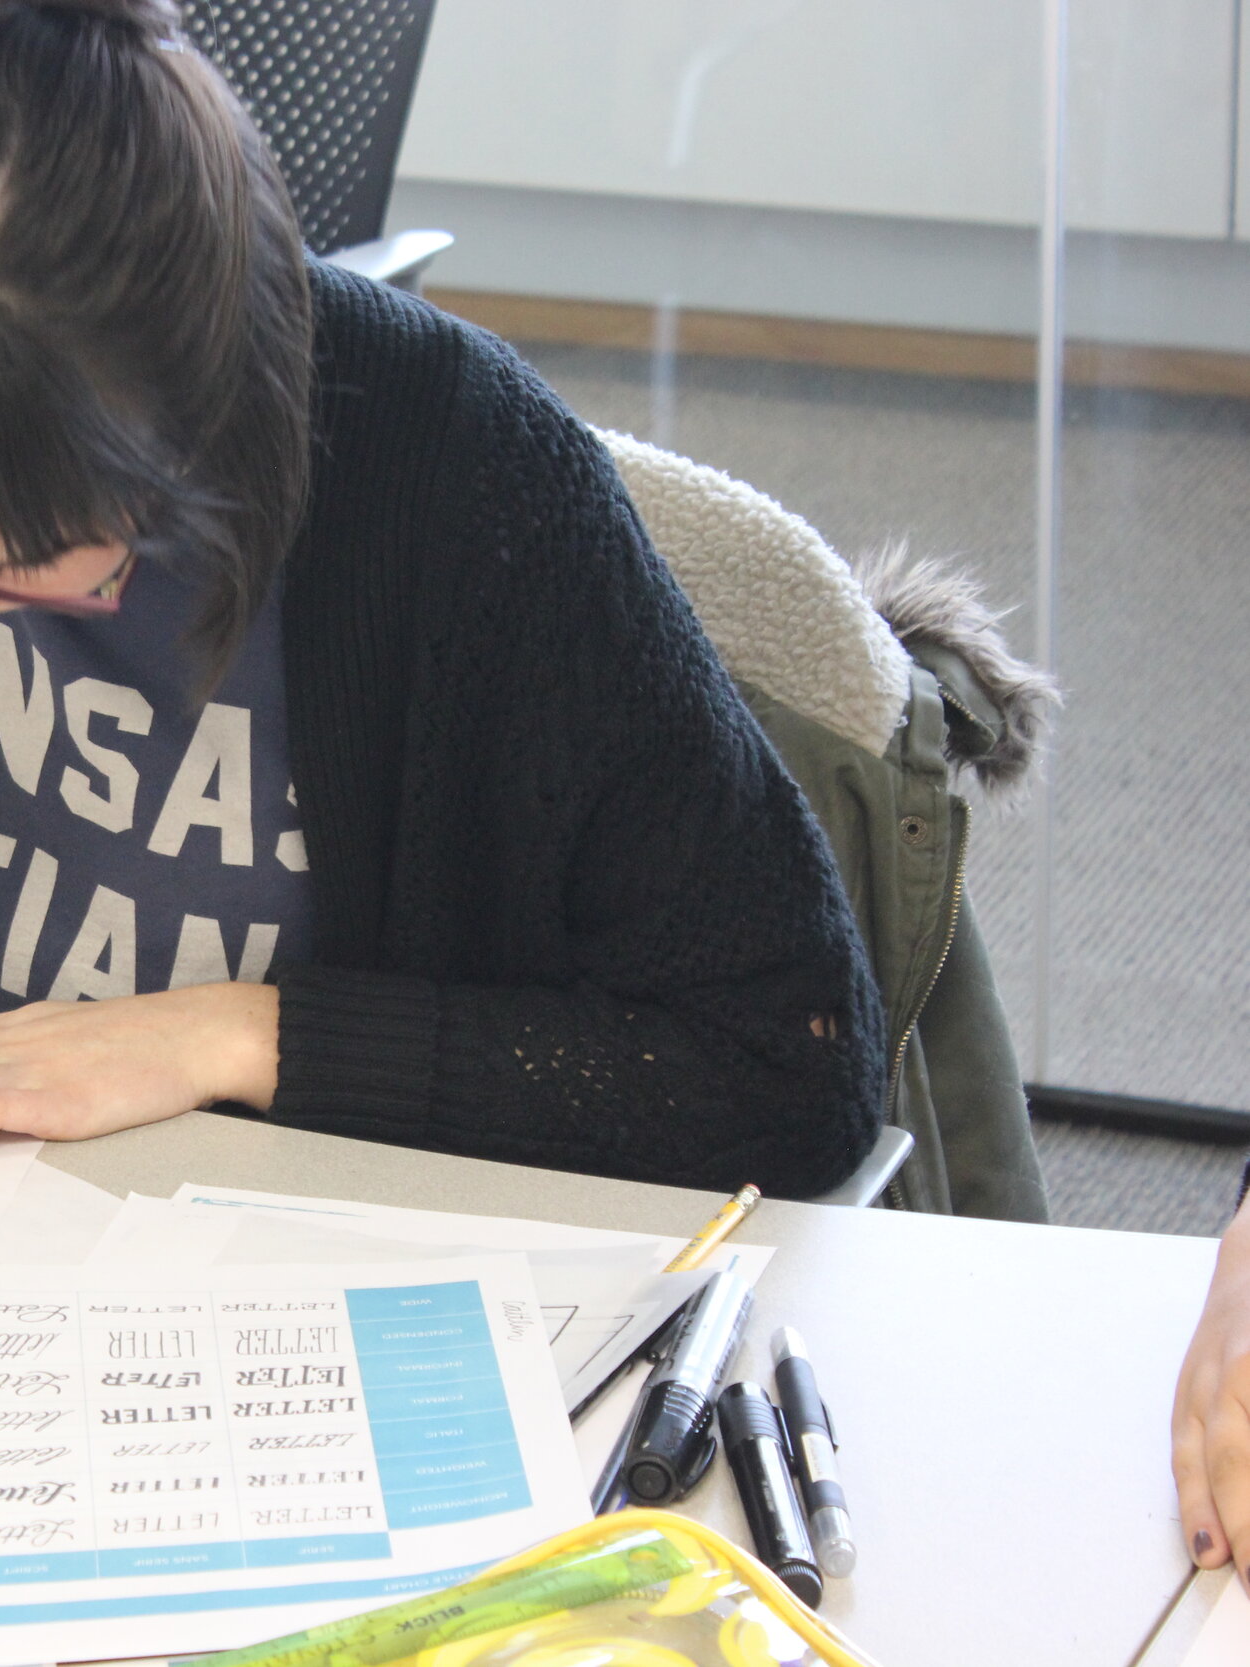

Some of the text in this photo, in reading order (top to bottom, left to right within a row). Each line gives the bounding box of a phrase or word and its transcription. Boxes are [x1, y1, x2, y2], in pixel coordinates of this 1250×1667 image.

[88, 1304, 202, 1314] LETTER
[221, 1302, 338, 1312] LETTER
[108, 1330, 196, 1360] LETTER
[234, 1326, 340, 1356] LETTER
[232, 1397, 358, 1418] LETTER
[413, 1394, 464, 1405] FORMAL
[101, 1405, 213, 1425] LETTER
[248, 1433, 358, 1451] LETTER
[424, 1428, 464, 1439] ITALIC
[112, 1441, 212, 1458] LETTER
[110, 1476, 220, 1494] LETTER
[248, 1470, 365, 1488] LETTER
[113, 1512, 219, 1534] LETTER
[254, 1505, 374, 1526] LETTER
[299, 1545, 335, 1555] SERIF
[133, 1553, 211, 1567] SANS SERIF
[3, 1564, 50, 1576] SCRIPT
[383, 1577, 430, 1592] CHART
[398, 1605, 467, 1631] BLICK
